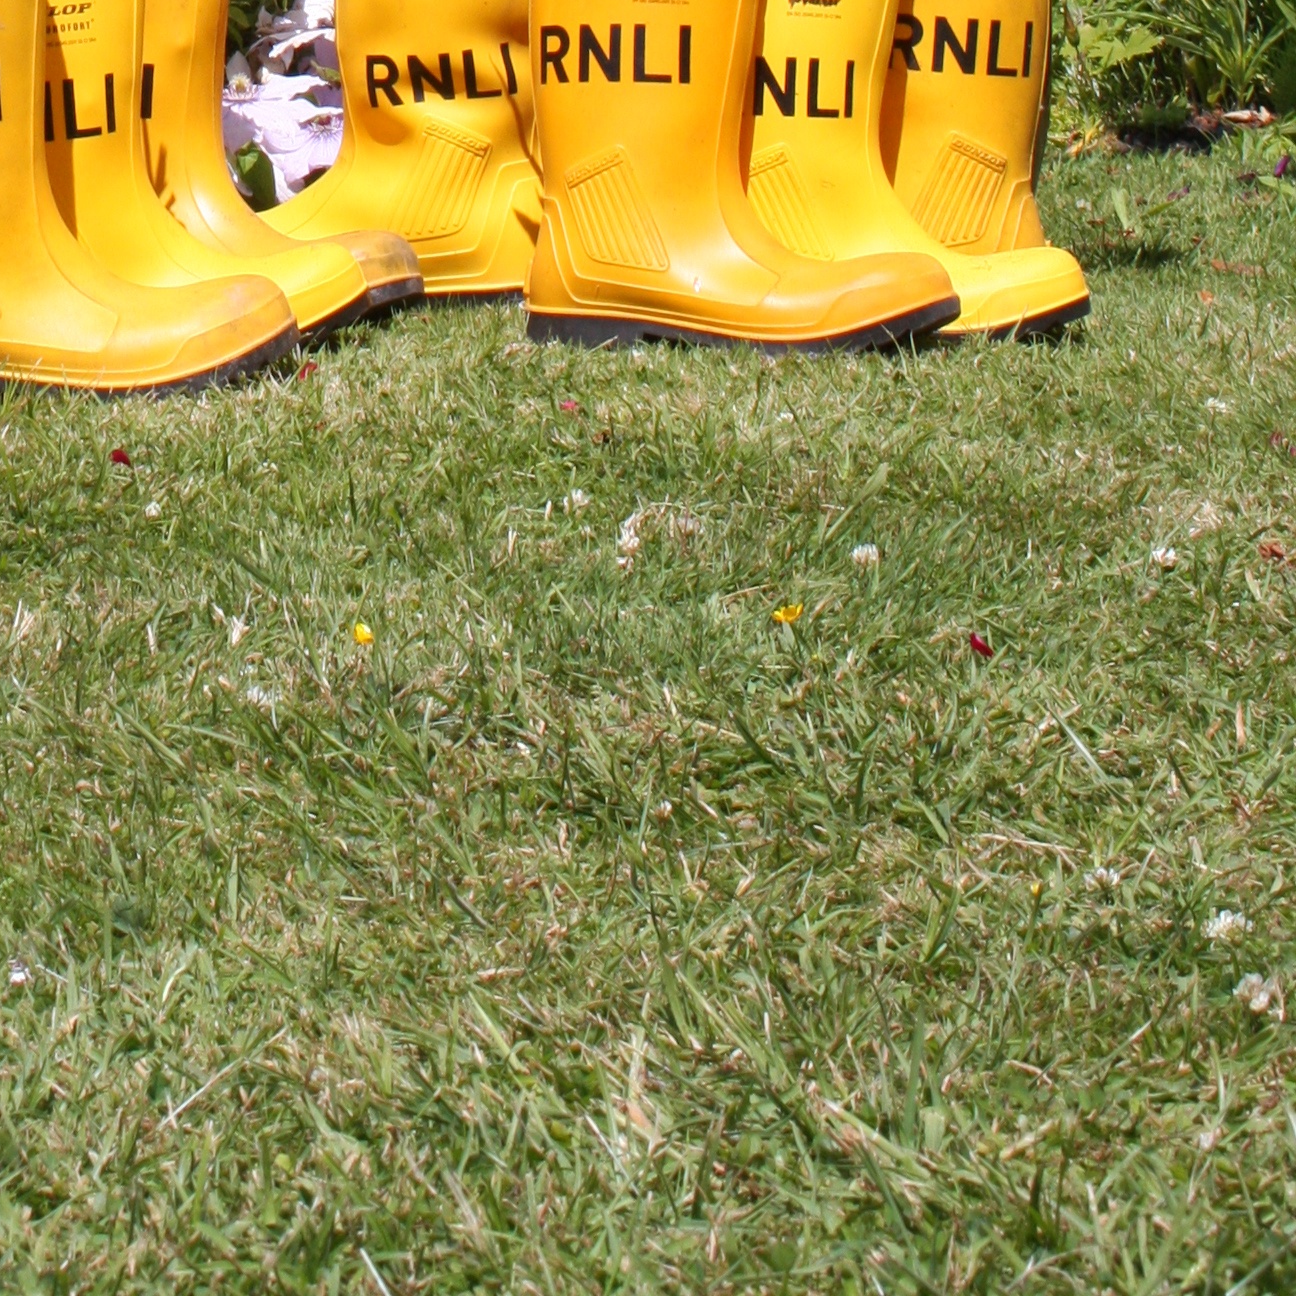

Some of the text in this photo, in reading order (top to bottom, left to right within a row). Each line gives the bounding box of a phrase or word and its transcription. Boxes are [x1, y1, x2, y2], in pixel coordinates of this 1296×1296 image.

[366, 42, 518, 108] RNLI
[541, 24, 692, 85] RNLI
[889, 13, 1034, 78] RNLI
[753, 56, 855, 119] NLI
[951, 139, 1005, 168] DUNLOP
